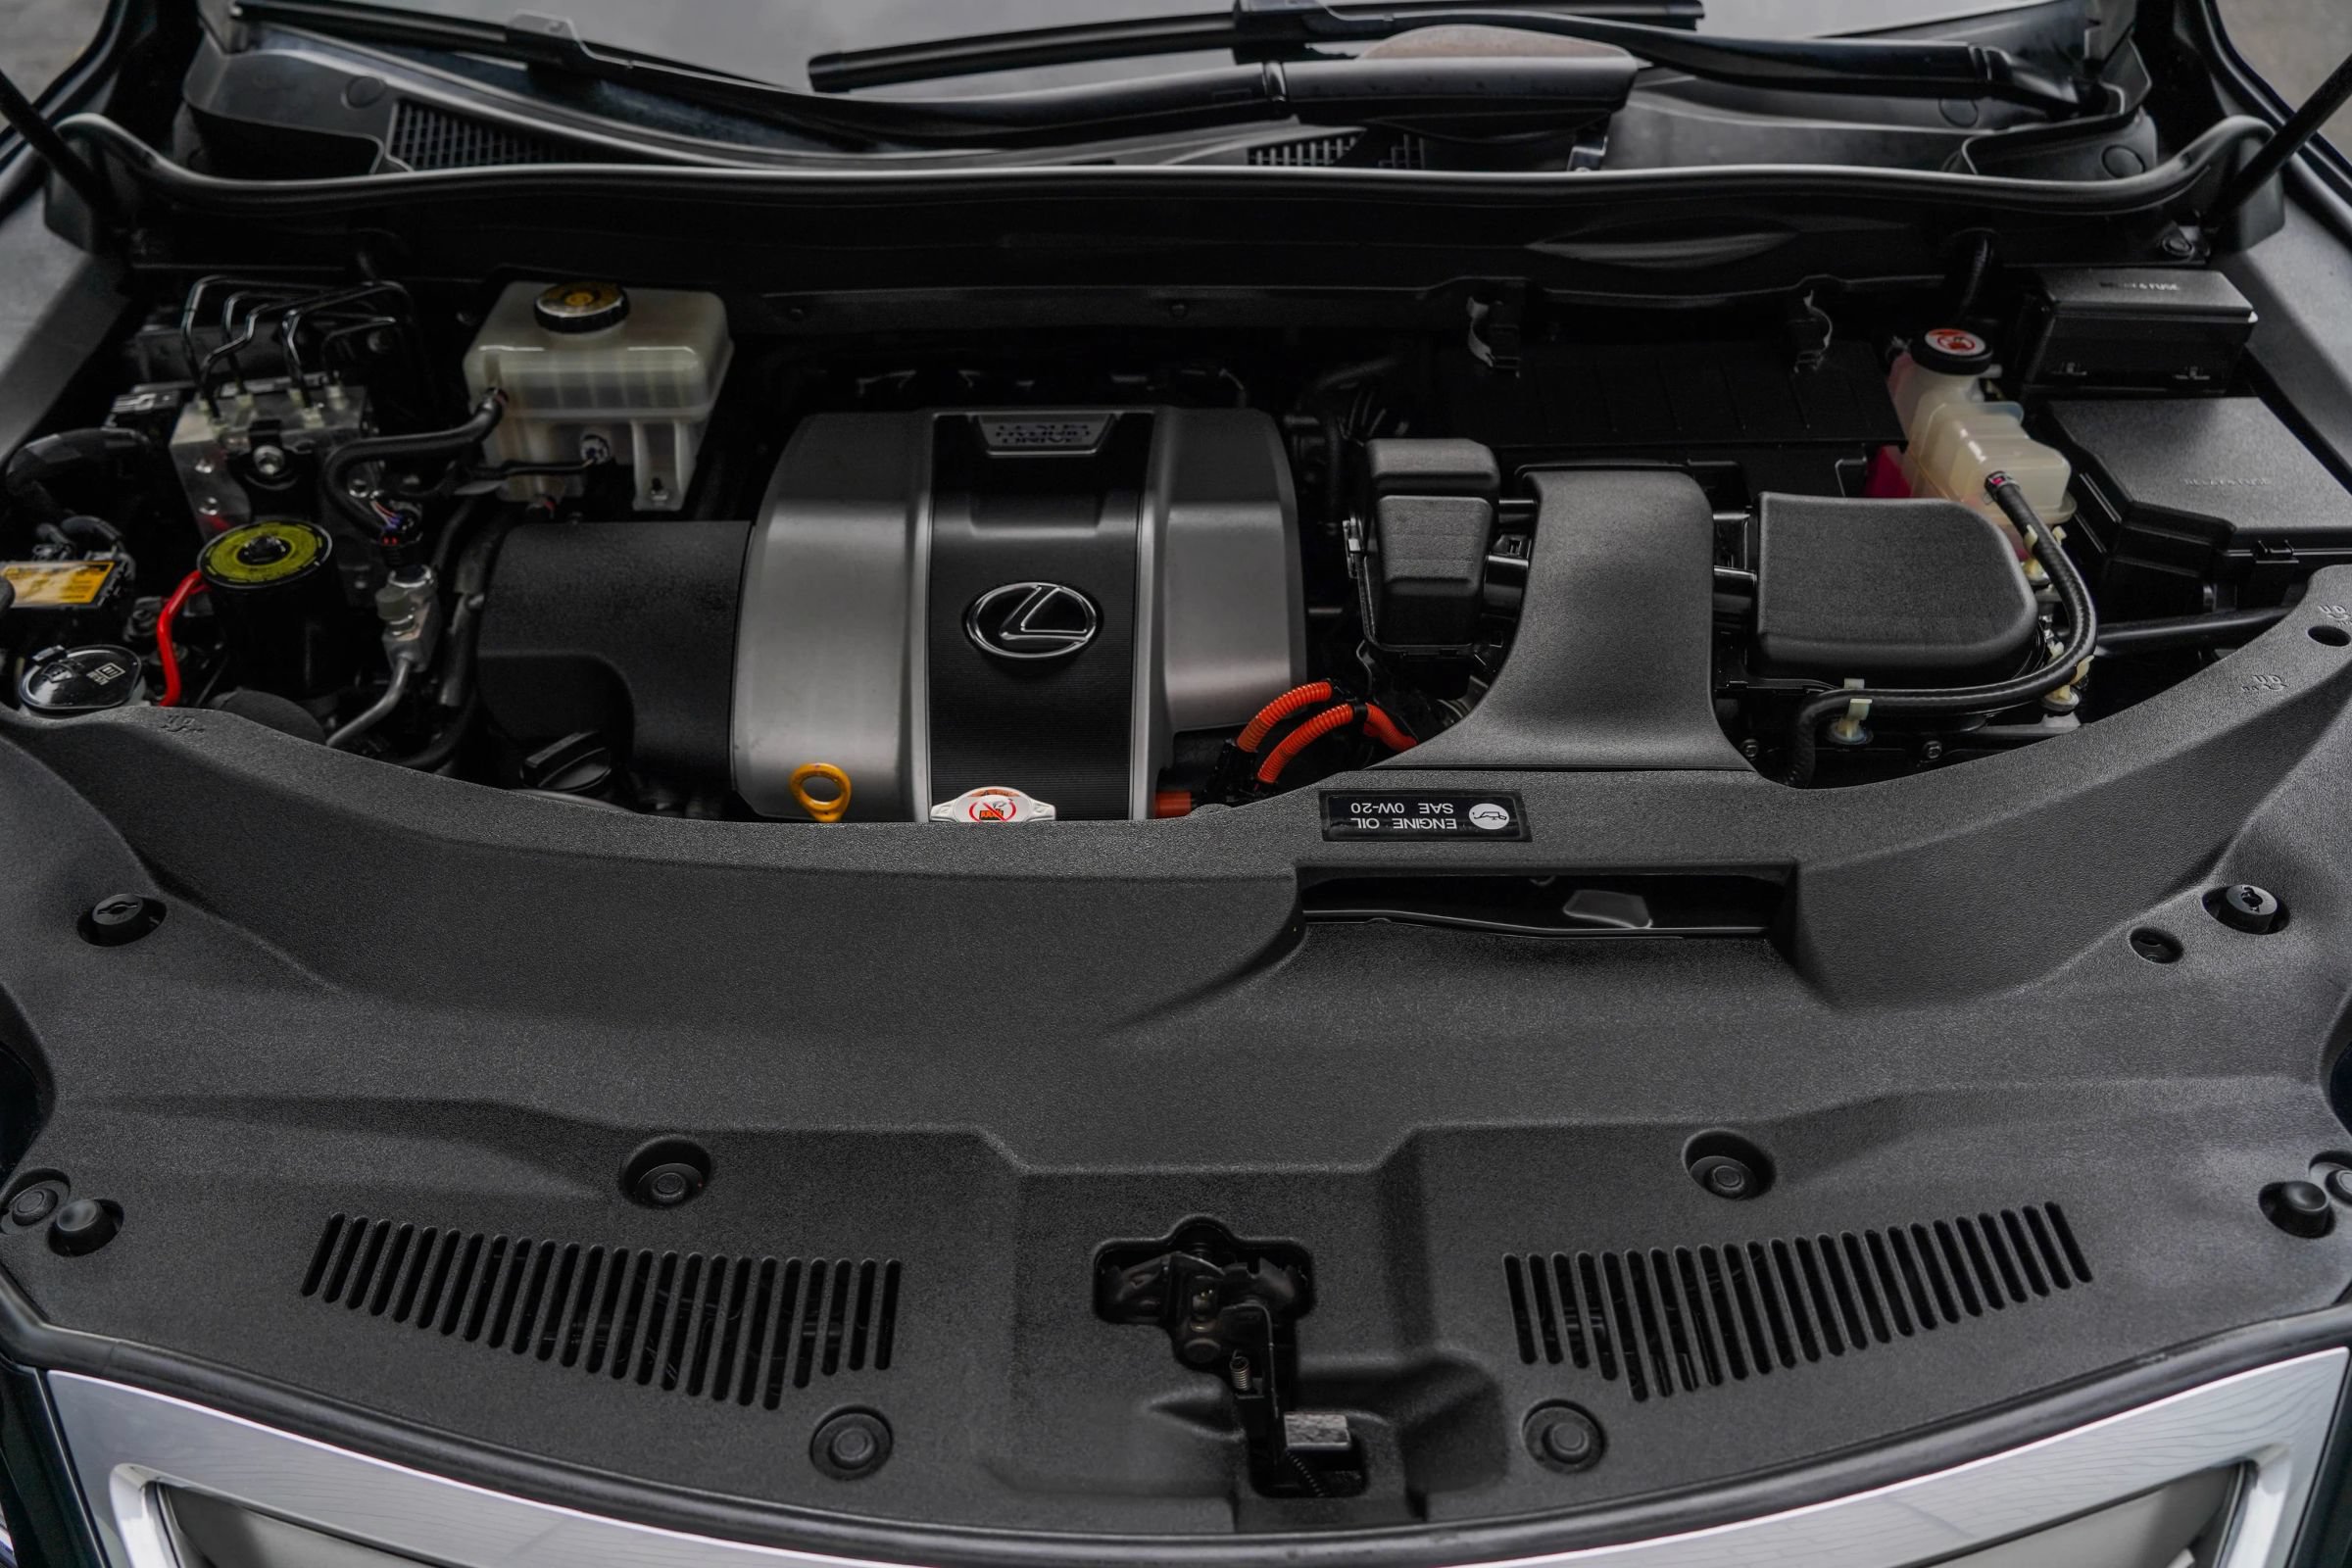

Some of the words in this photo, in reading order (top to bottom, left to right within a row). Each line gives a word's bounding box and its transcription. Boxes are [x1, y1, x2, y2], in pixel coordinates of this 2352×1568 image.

[1350, 803, 1405, 814] 0W-20
[1418, 803, 1454, 814] SAE
[1350, 817, 1380, 830] OIL
[1392, 817, 1457, 830] ENGINE
